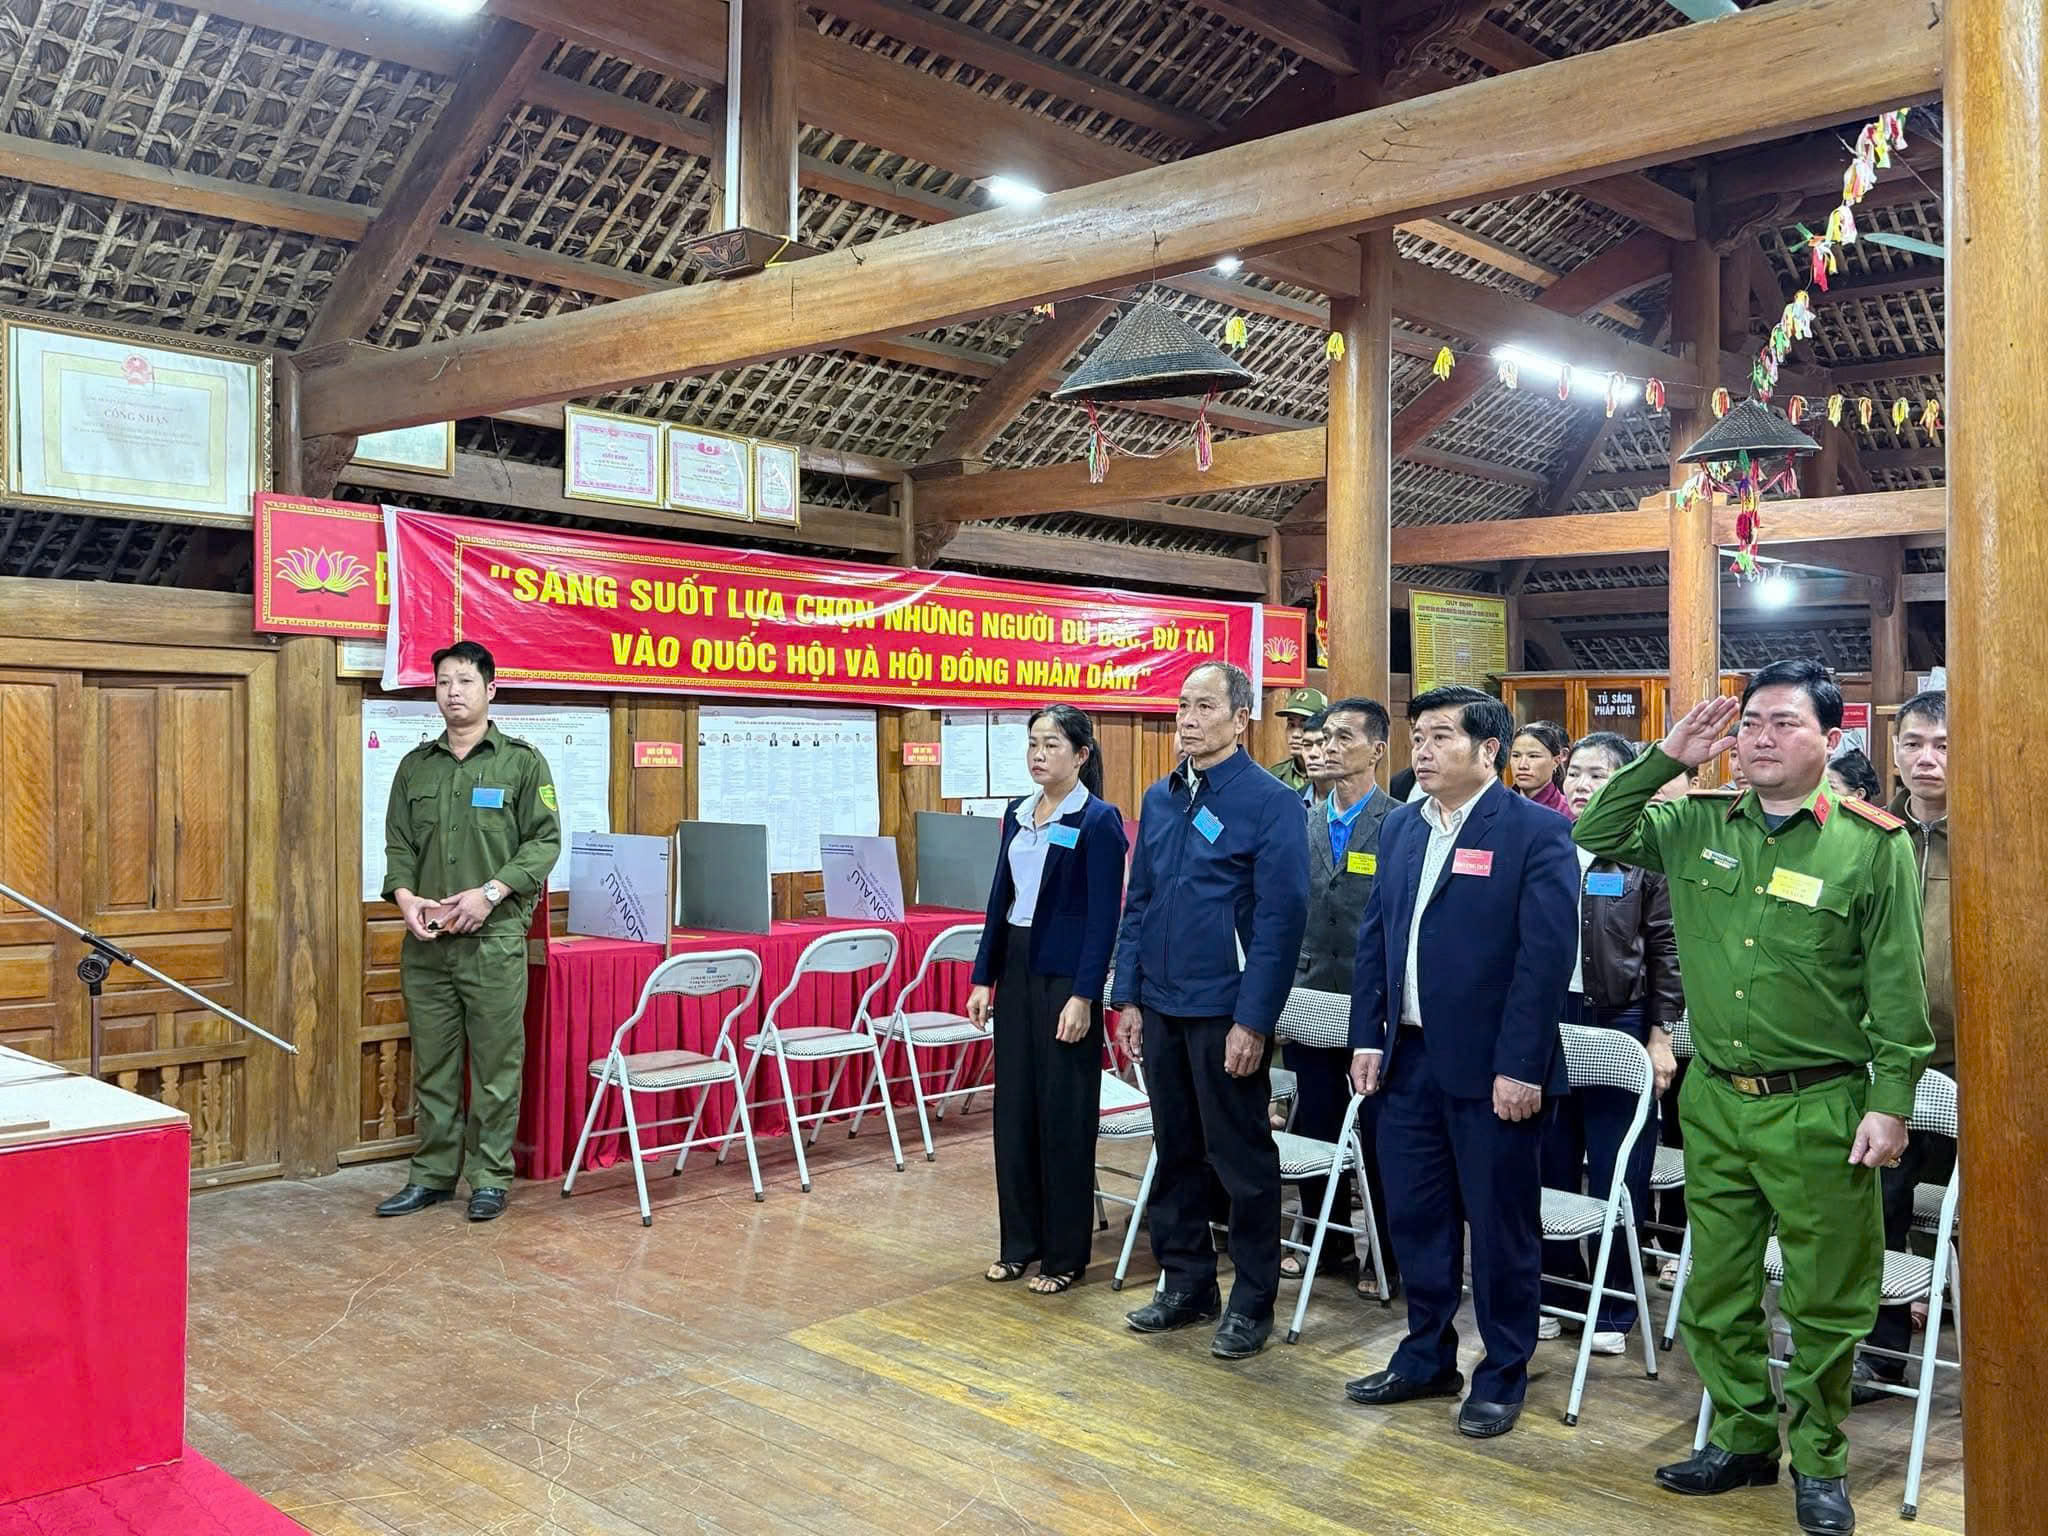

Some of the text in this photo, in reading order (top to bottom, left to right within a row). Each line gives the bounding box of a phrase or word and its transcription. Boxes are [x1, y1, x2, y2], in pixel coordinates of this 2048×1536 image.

[630, 573, 718, 617] SUỐT
[728, 588, 786, 627] LỰA
[796, 594, 876, 634] CHỌN
[884, 601, 974, 637] NHỮNG
[981, 609, 1055, 643] NGƯỜI
[1152, 620, 1181, 652] ĐỦ
[1186, 625, 1215, 654] TÀI
[611, 627, 681, 669] VÀO
[691, 631, 777, 673] QUỐC
[786, 640, 837, 682] HỘI
[844, 643, 880, 678] VÀ
[888, 647, 933, 687] HỘI
[940, 647, 1009, 685] ĐỒNG
[1016, 656, 1081, 689] NHÂN
[1594, 703, 1636, 718] PHÁP LUẬT
[1597, 691, 1633, 704] TỦ SÁCH
[605, 873, 625, 904] ALU
[851, 870, 872, 898] ALU
[869, 896, 893, 922] ON
